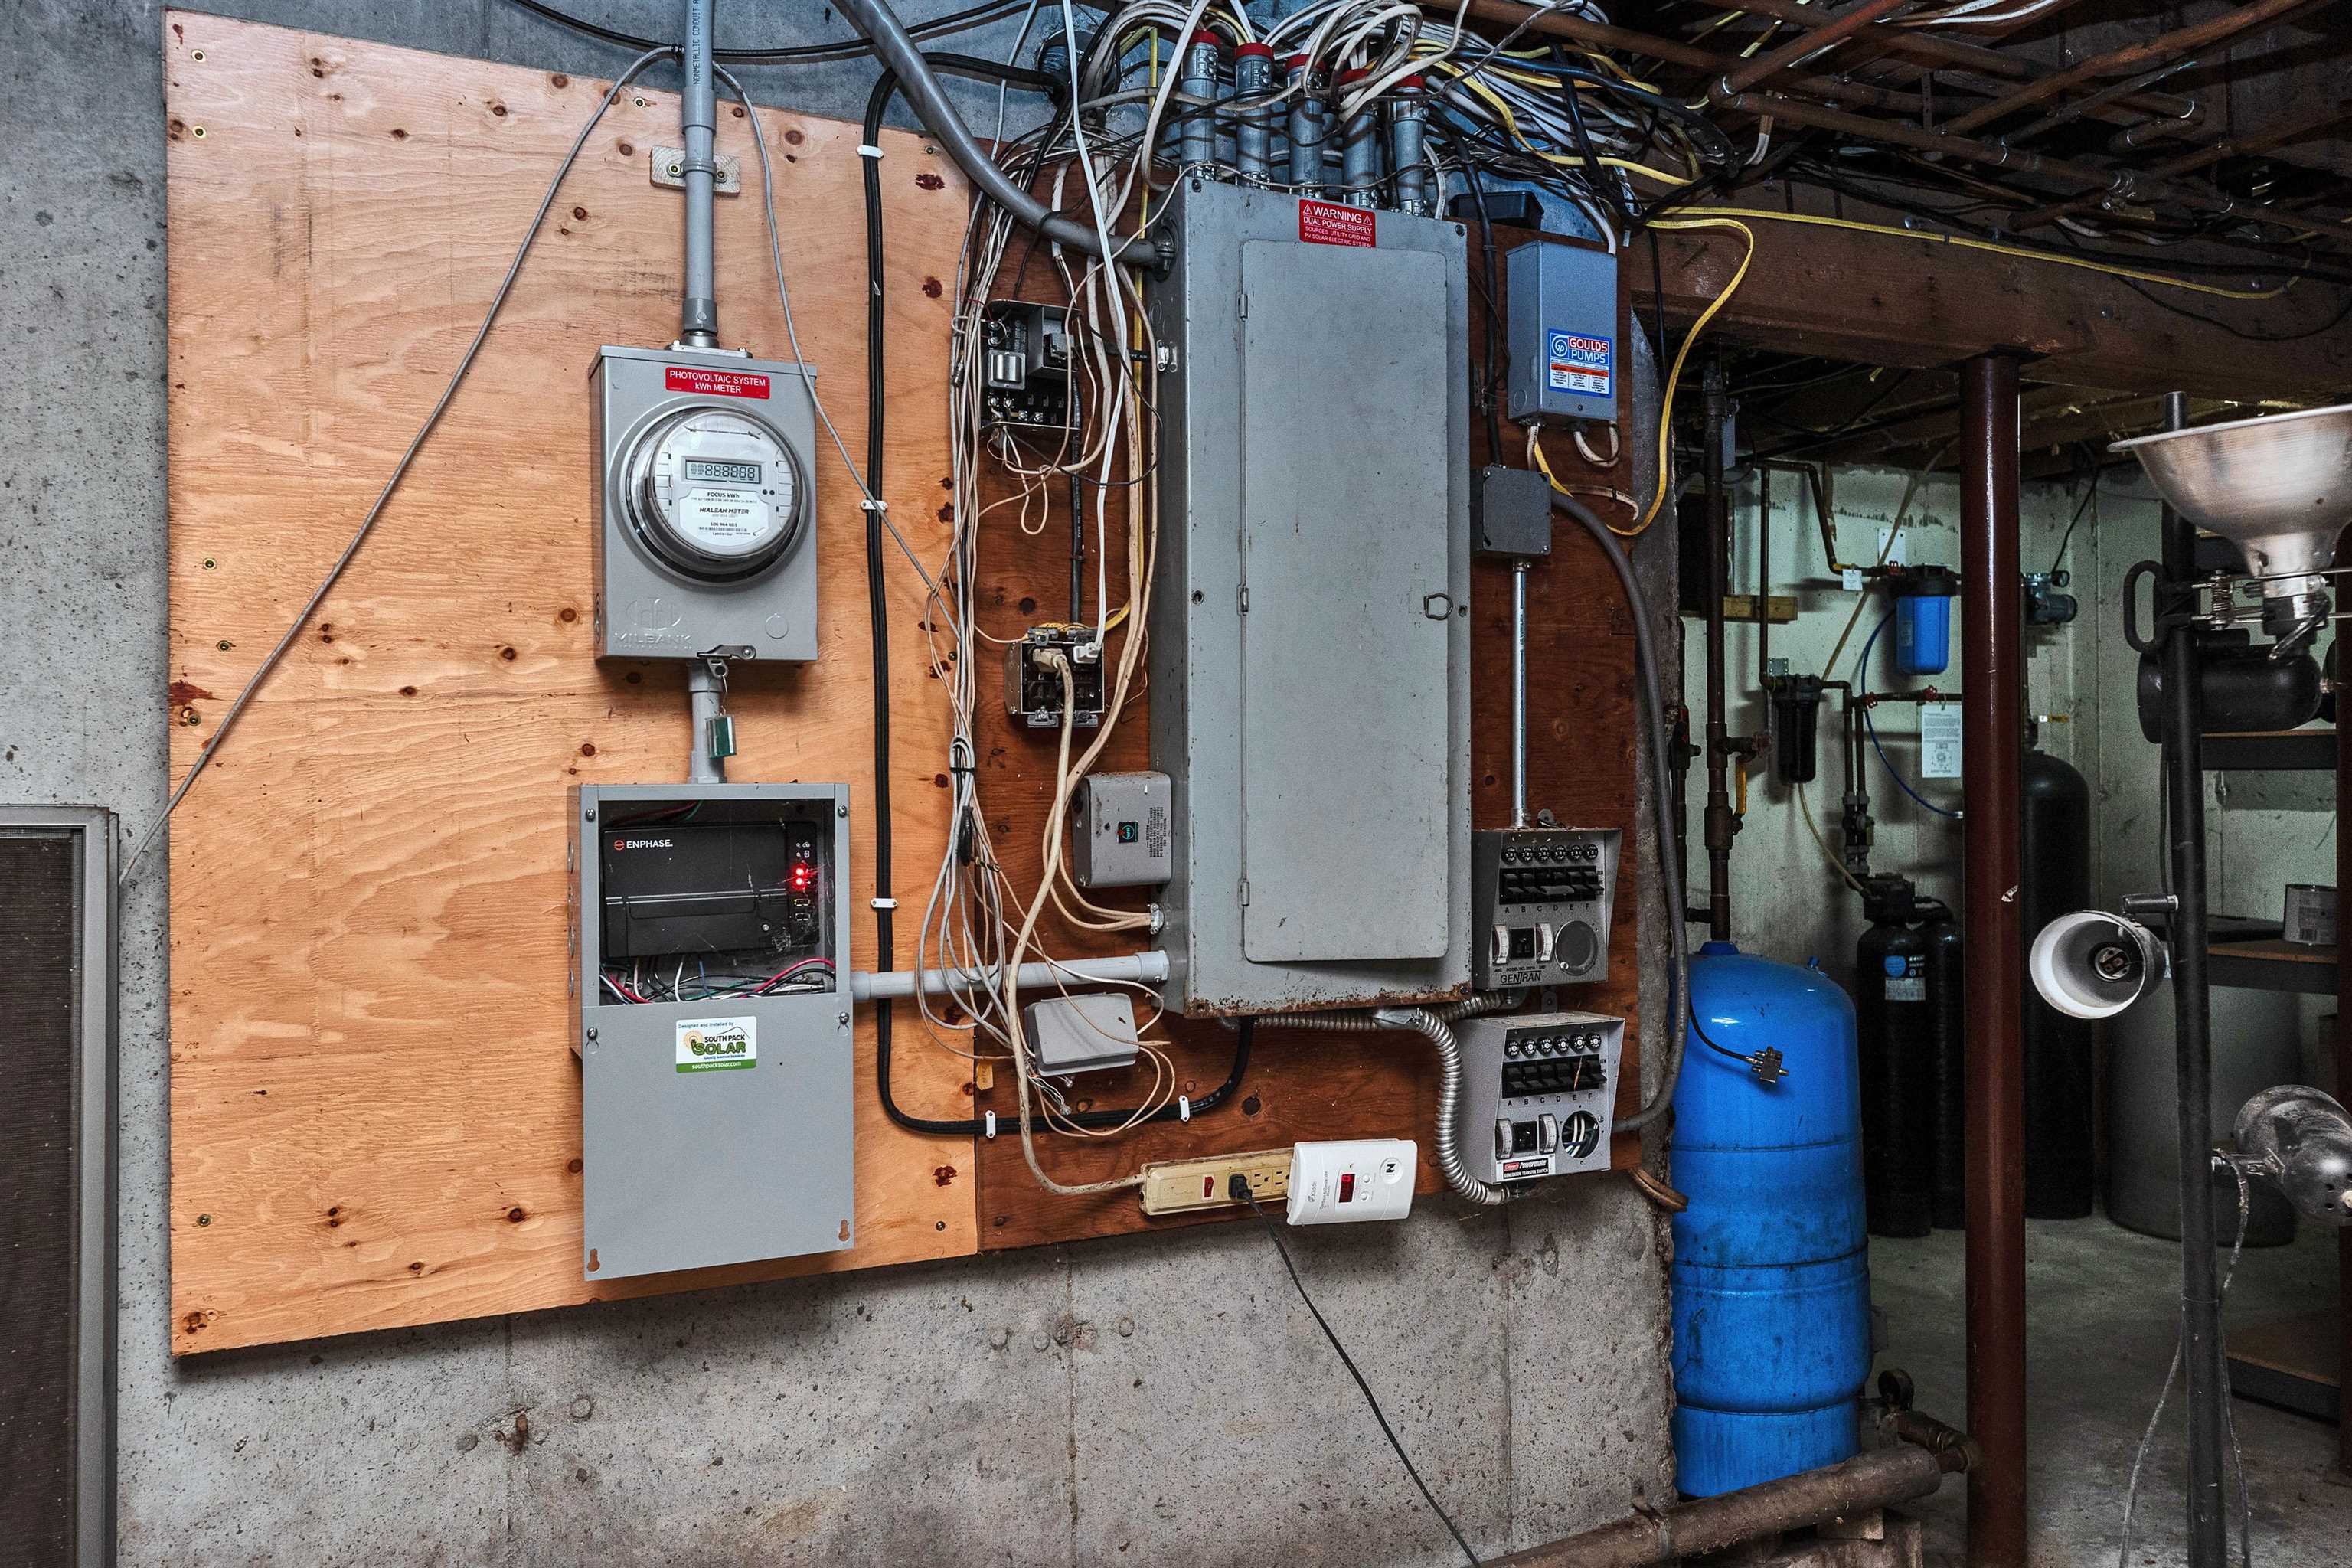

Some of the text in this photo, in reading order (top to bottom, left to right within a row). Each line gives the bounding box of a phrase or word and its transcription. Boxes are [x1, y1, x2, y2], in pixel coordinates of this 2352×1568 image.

[1313, 206, 1362, 224] WARNING
[1304, 217, 1372, 234] DUAL POWER SUPPLY
[1329, 236, 1352, 245] ELECTRIC
[1353, 240, 1371, 248] SYSTEM
[1570, 338, 1608, 352] GOULDS
[1571, 351, 1606, 364] PUMPS
[669, 370, 766, 387] PHOTOVOLTAIC SYSTEM
[695, 382, 741, 394] kWh METER
[1500, 970, 1542, 985] GENTRAN
[691, 1041, 746, 1056] SOLAR
